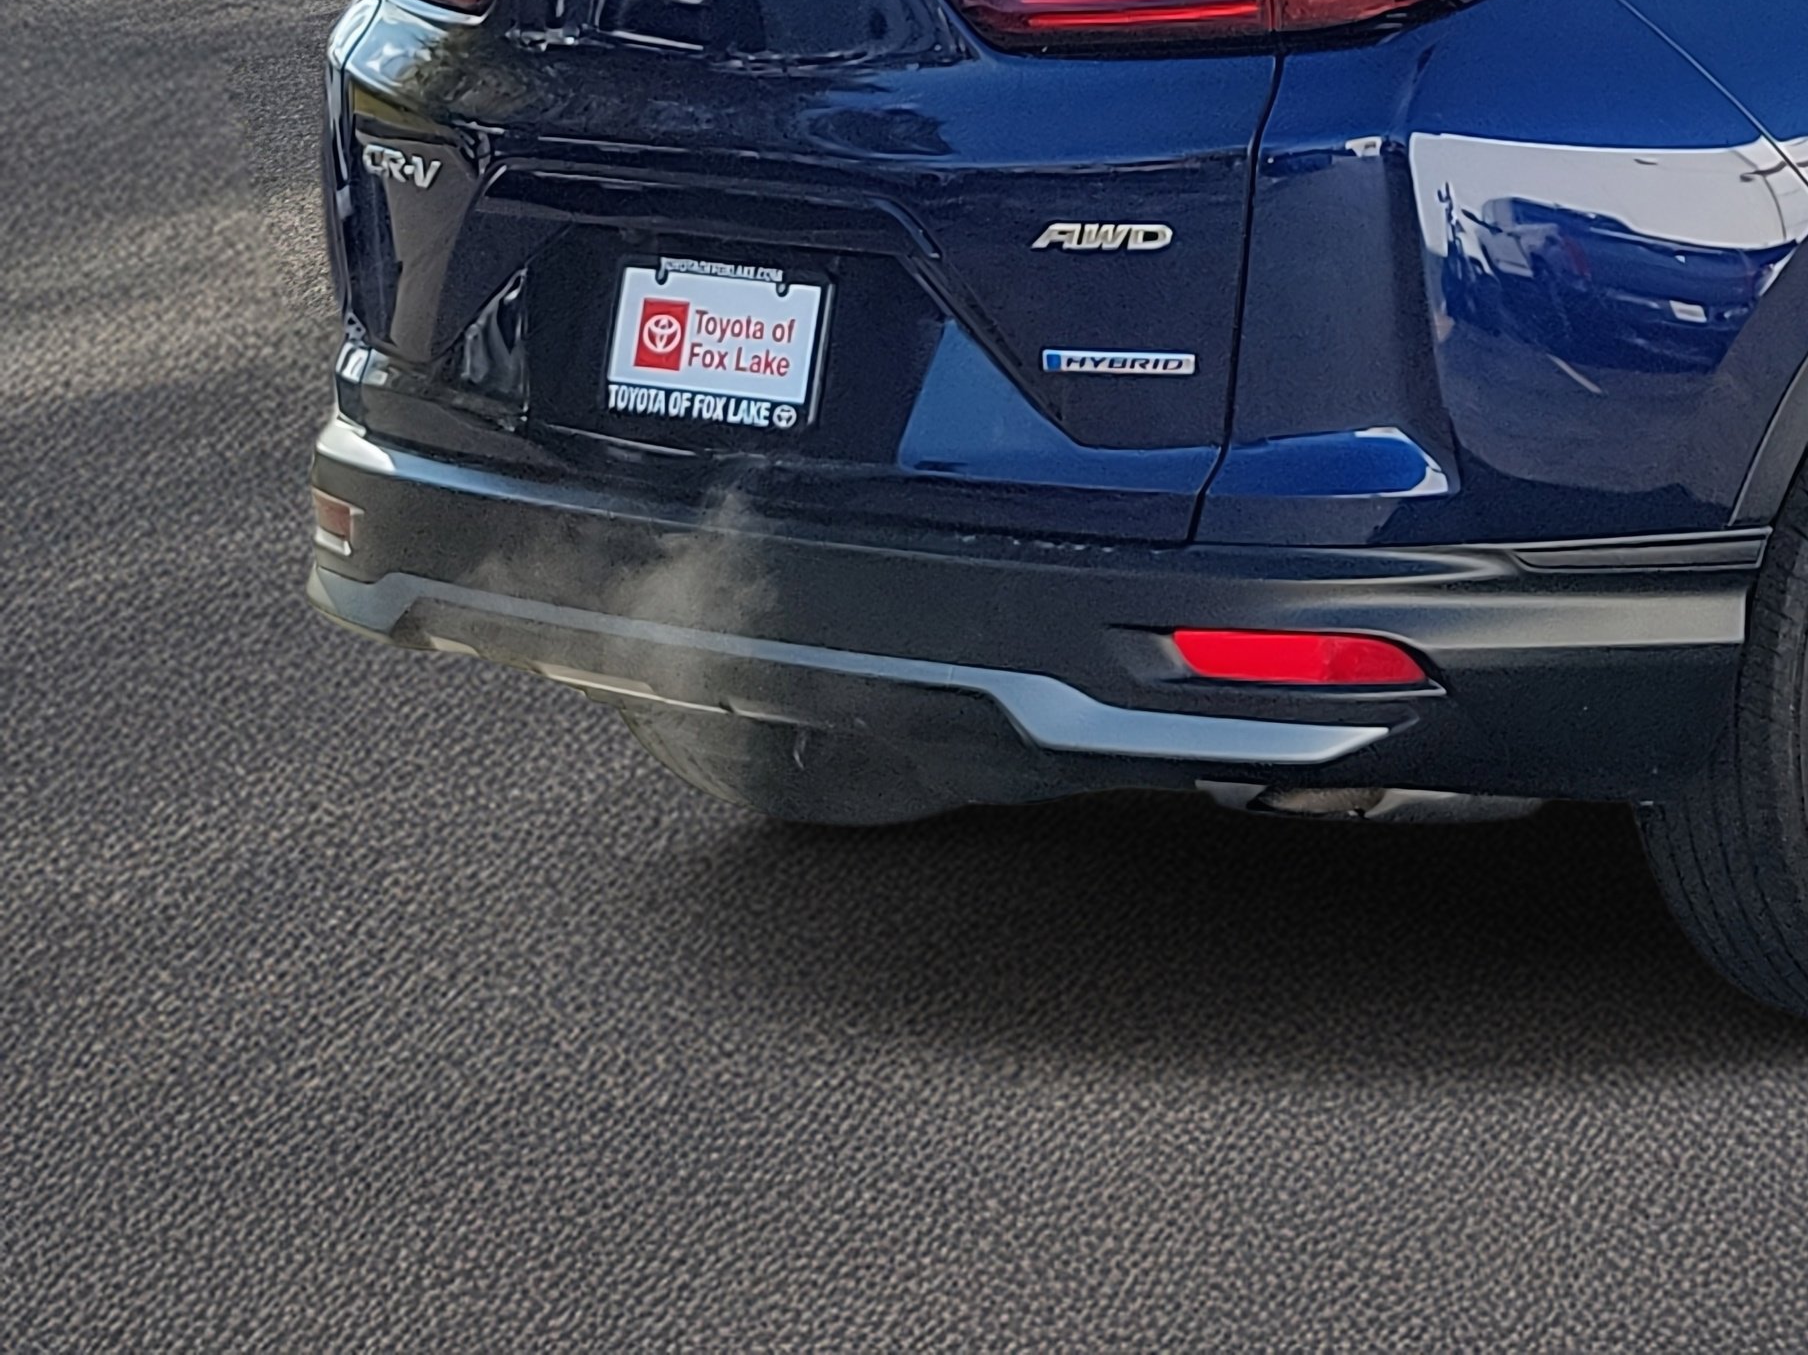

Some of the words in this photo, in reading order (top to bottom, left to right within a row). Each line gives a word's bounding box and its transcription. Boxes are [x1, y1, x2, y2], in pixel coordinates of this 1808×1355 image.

[362, 143, 442, 189] CR-V
[1030, 222, 1174, 251] AWD
[696, 309, 765, 343] Toyota
[772, 318, 796, 343] of
[688, 343, 729, 371] Fox
[735, 347, 790, 377] Lake
[1066, 356, 1183, 371] HYBRID
[608, 384, 666, 416] TOYOTA
[668, 391, 692, 418] OF
[692, 394, 727, 422] FOX
[726, 398, 771, 427] LAKE
